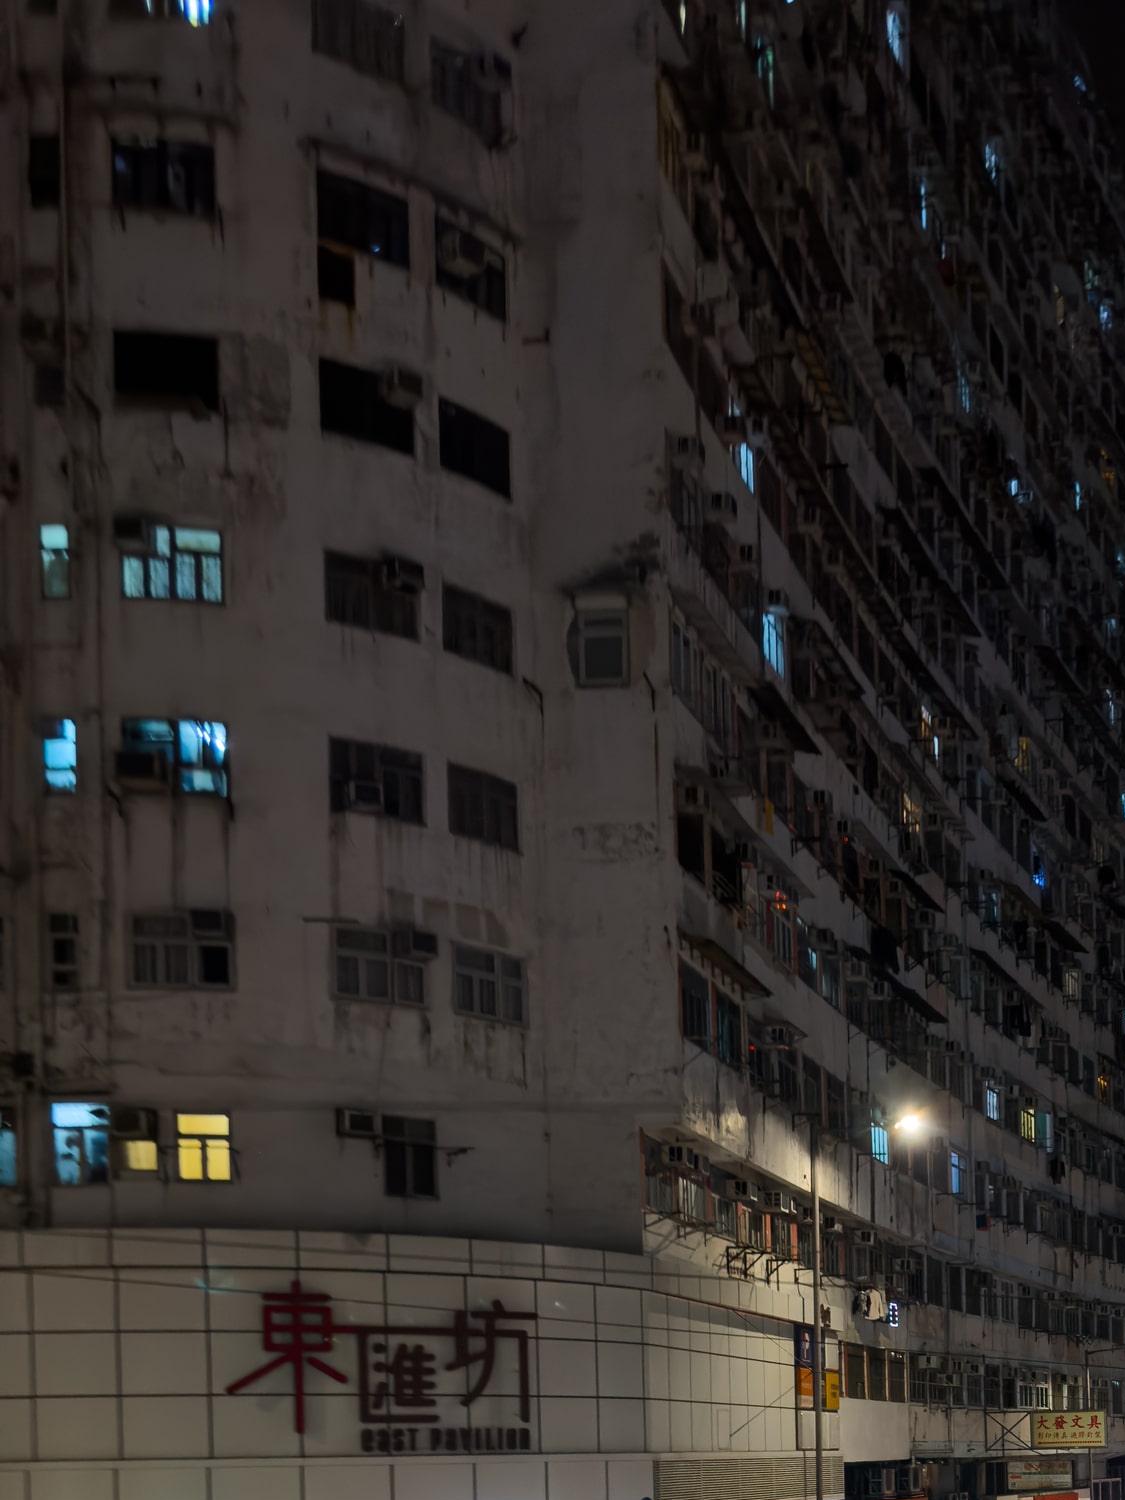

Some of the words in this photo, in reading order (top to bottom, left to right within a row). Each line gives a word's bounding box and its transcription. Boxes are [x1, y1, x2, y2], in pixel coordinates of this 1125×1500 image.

[226, 1279, 539, 1435] 東匯坊
[1036, 1415, 1102, 1430] 大發文具
